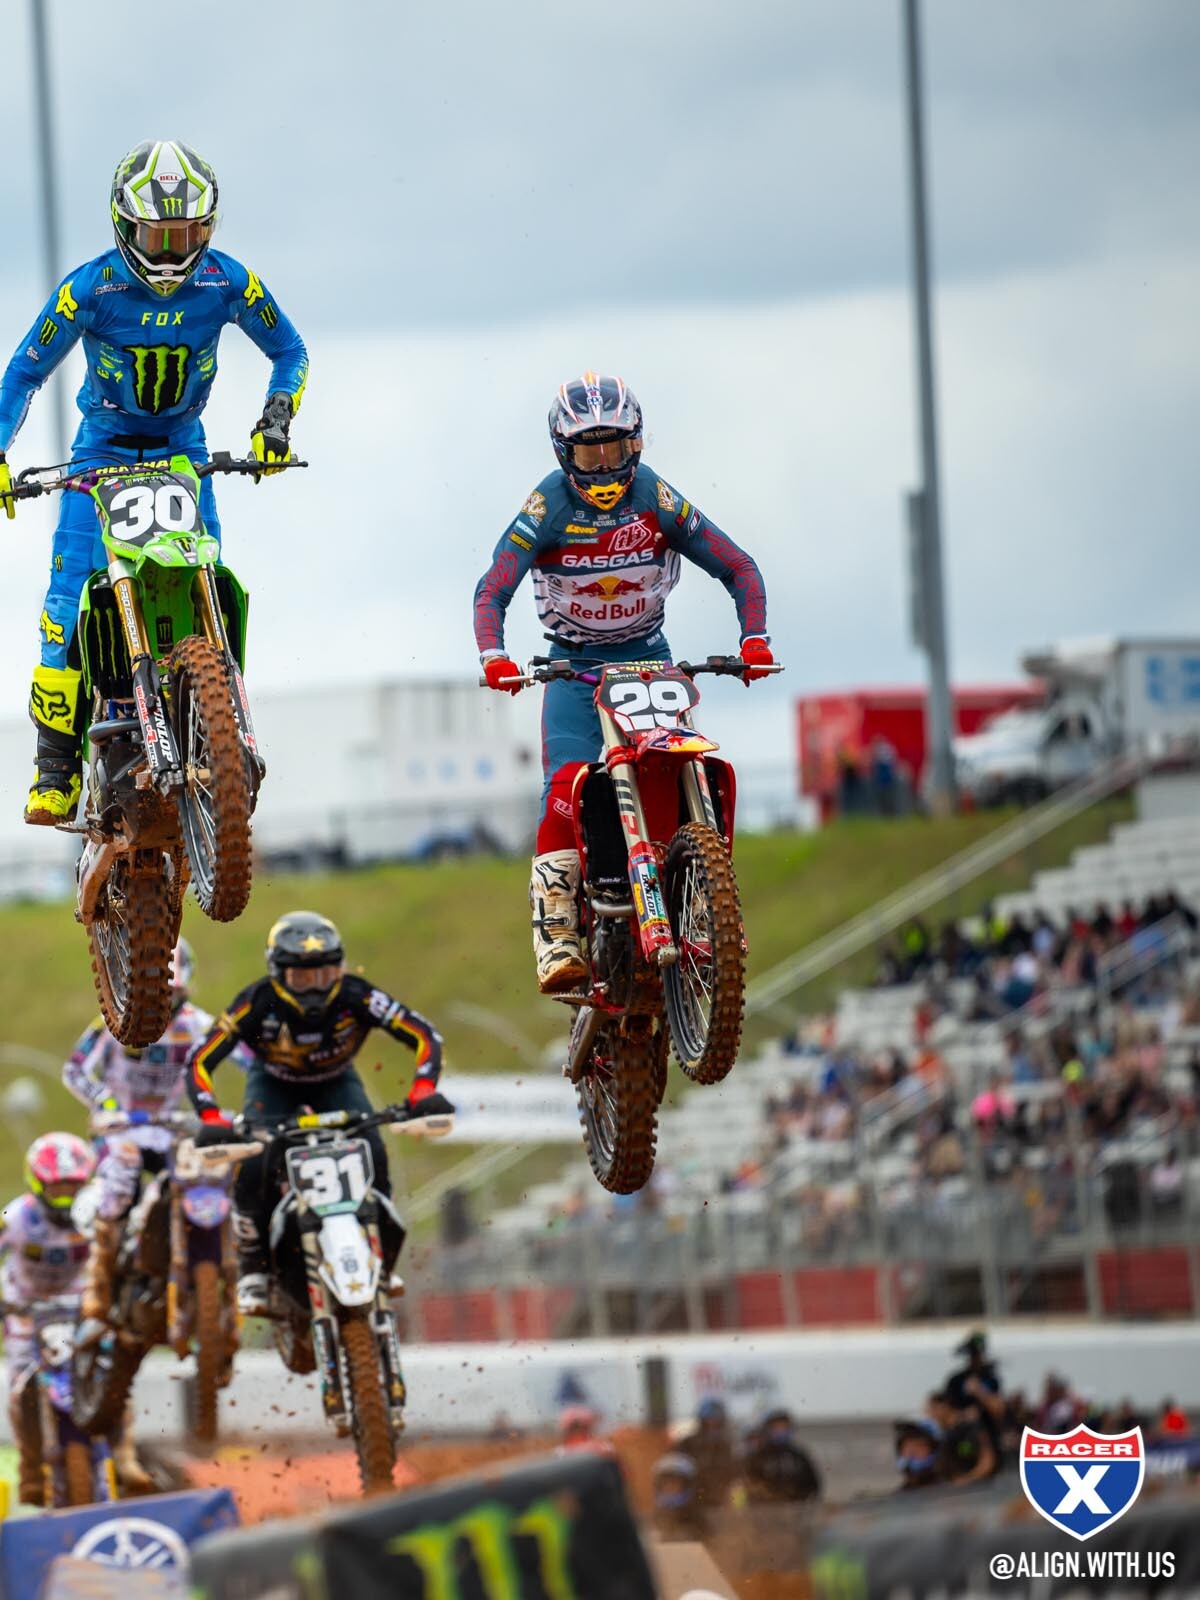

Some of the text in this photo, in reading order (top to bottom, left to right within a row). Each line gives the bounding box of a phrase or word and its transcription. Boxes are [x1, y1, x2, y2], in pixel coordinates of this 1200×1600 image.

[140, 311, 185, 326] FOX
[109, 485, 197, 541] 30
[592, 519, 617, 527] PICTURES
[562, 547, 654, 569] GASGAS
[118, 583, 141, 650] PRO CIRCUIT
[569, 597, 646, 620] Red Bull
[609, 680, 691, 732] 29
[300, 1153, 367, 1206] 31
